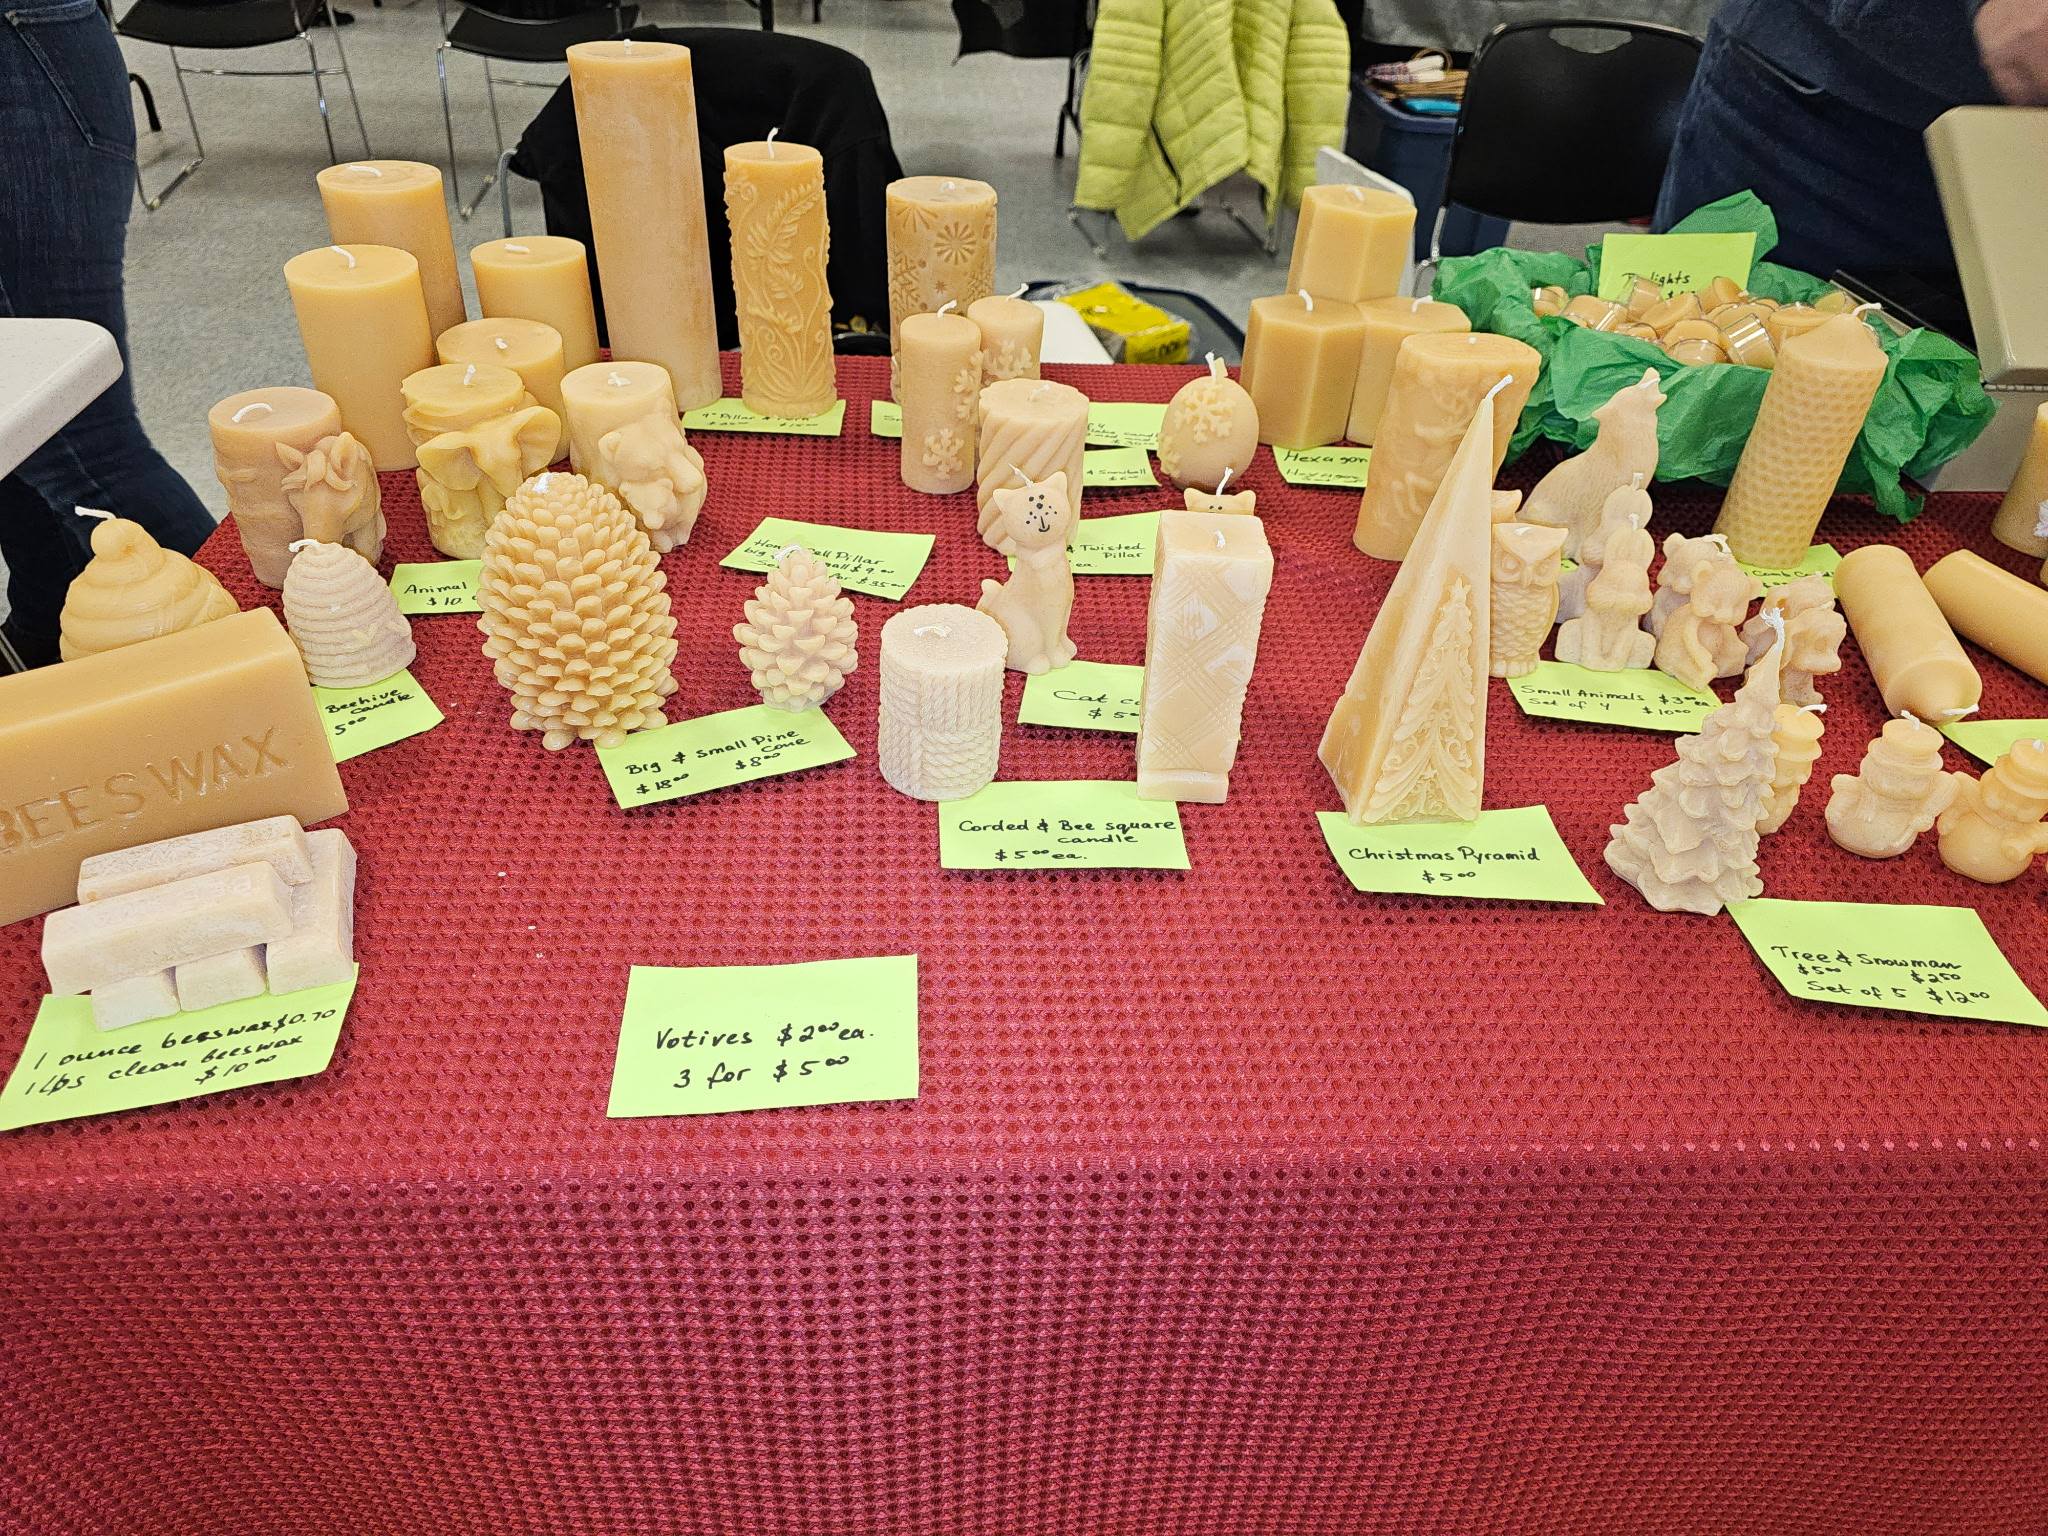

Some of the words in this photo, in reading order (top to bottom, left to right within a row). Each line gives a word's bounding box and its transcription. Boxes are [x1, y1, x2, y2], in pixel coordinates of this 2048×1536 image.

[1080, 542, 1146, 552] Twisted
[1104, 551, 1143, 559] Pillar
[836, 551, 885, 565] Pillar
[404, 581, 467, 594] Animal
[325, 689, 399, 714] Beehive
[1053, 690, 1109, 704] Cat
[1520, 684, 1571, 698] Small
[1577, 689, 1646, 702] Animals
[1528, 697, 1558, 707] Set
[1569, 700, 1588, 710] of
[696, 739, 747, 759] Small
[752, 729, 800, 745] Pine
[0, 727, 290, 852] BEESWAX
[958, 819, 1029, 832] Corded
[1058, 820, 1096, 832] Bee
[1105, 820, 1177, 835] square
[1057, 834, 1139, 844] candle
[1349, 847, 1455, 862] Christmas
[1457, 846, 1541, 864] Pyramid
[1771, 945, 1832, 963] Tree
[1857, 953, 1963, 970] Snowman
[1807, 980, 1852, 995] Set
[1860, 986, 1883, 1000] of
[1891, 987, 1907, 998] 5
[58, 1043, 143, 1067] ounce
[161, 1018, 272, 1050] beeswax
[656, 1027, 753, 1050] Votives
[108, 1059, 189, 1081] clean
[200, 1034, 305, 1065] beeswax
[673, 1067, 692, 1089] 3
[707, 1062, 752, 1090] for
